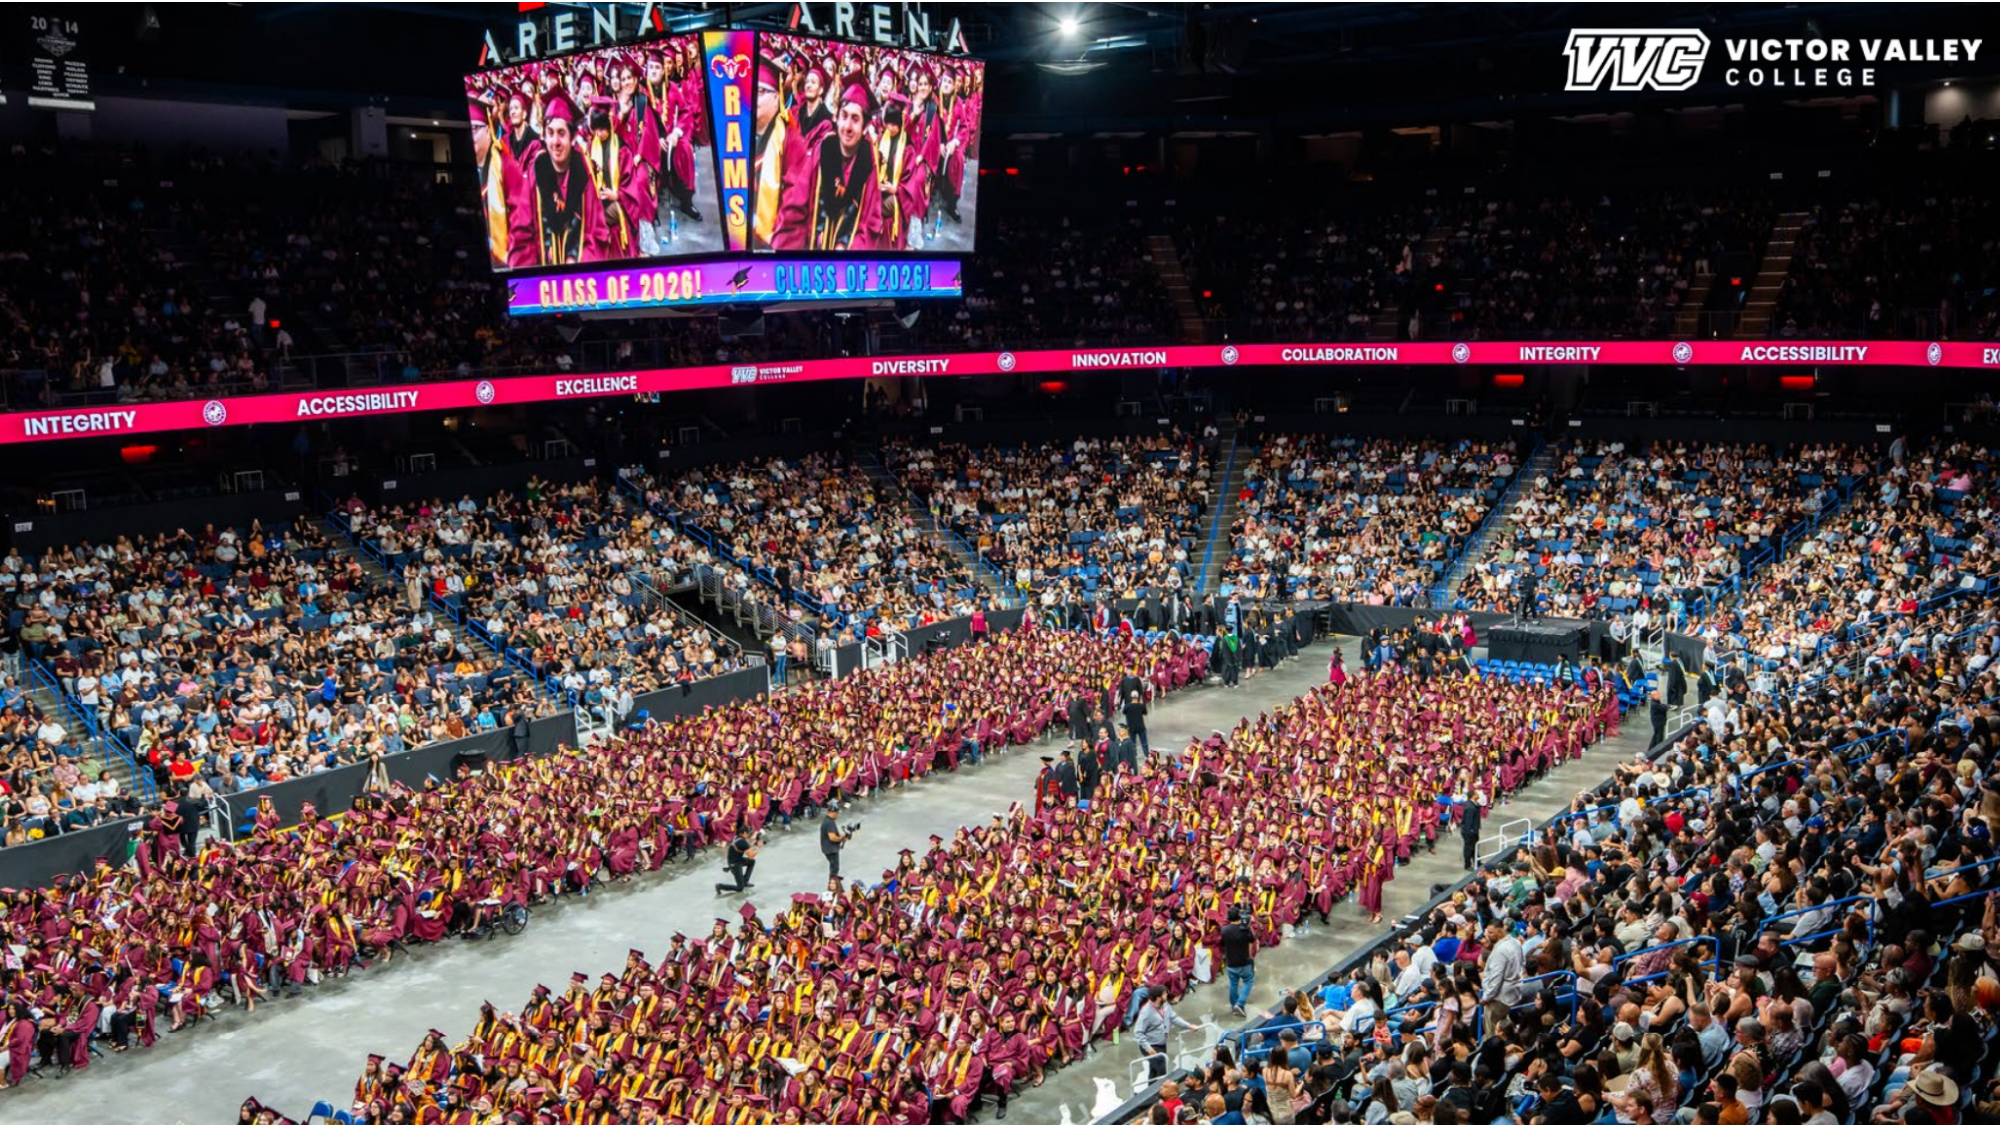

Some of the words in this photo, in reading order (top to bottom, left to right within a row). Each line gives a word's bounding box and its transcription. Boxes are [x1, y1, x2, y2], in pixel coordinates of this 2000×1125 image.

[30, 16, 47, 30] 20
[65, 21, 79, 34] 14
[478, 2, 664, 66] ARENA
[788, 2, 970, 54] ARENA
[722, 84, 748, 227] RAMS
[775, 263, 837, 294] CLASS
[846, 264, 868, 293] OF
[877, 263, 932, 292] 2026!
[539, 277, 598, 308] CLASS
[607, 275, 630, 304] OF
[640, 269, 702, 302] 2026!
[1072, 352, 1166, 367] INNOVATION
[1281, 347, 1398, 362] COLLABORATION
[1519, 346, 1601, 361] INTEGRITY
[1741, 346, 1868, 361] ACCESSIBILITY
[1983, 348, 2000, 364] EX
[731, 366, 757, 384] VVC
[760, 367, 781, 375] VICTOR
[782, 365, 803, 373] VALLEY
[872, 359, 949, 375] DIVERSITY
[556, 376, 638, 395] EXCELLENCE
[297, 390, 419, 416] ACCESSIBILITY
[23, 410, 136, 436] INTEGRITY
